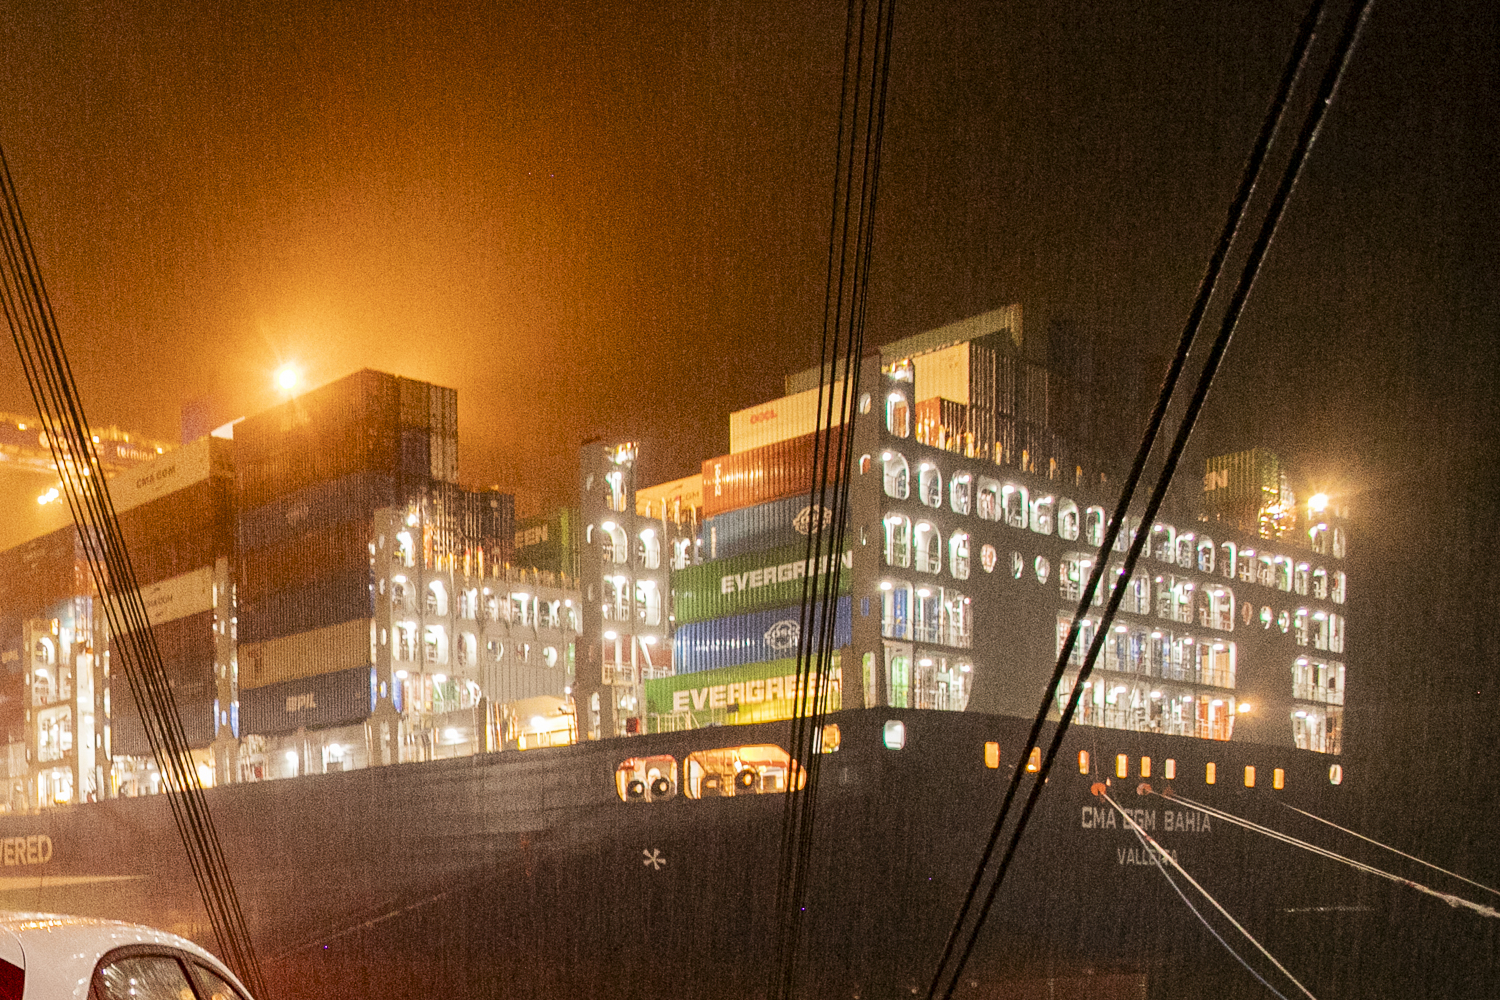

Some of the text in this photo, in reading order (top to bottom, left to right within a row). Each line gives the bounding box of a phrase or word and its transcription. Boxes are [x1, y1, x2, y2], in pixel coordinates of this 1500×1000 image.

[721, 550, 853, 595] EVERGREEN
[1081, 806, 1212, 833] CMA CGM BAHIA
